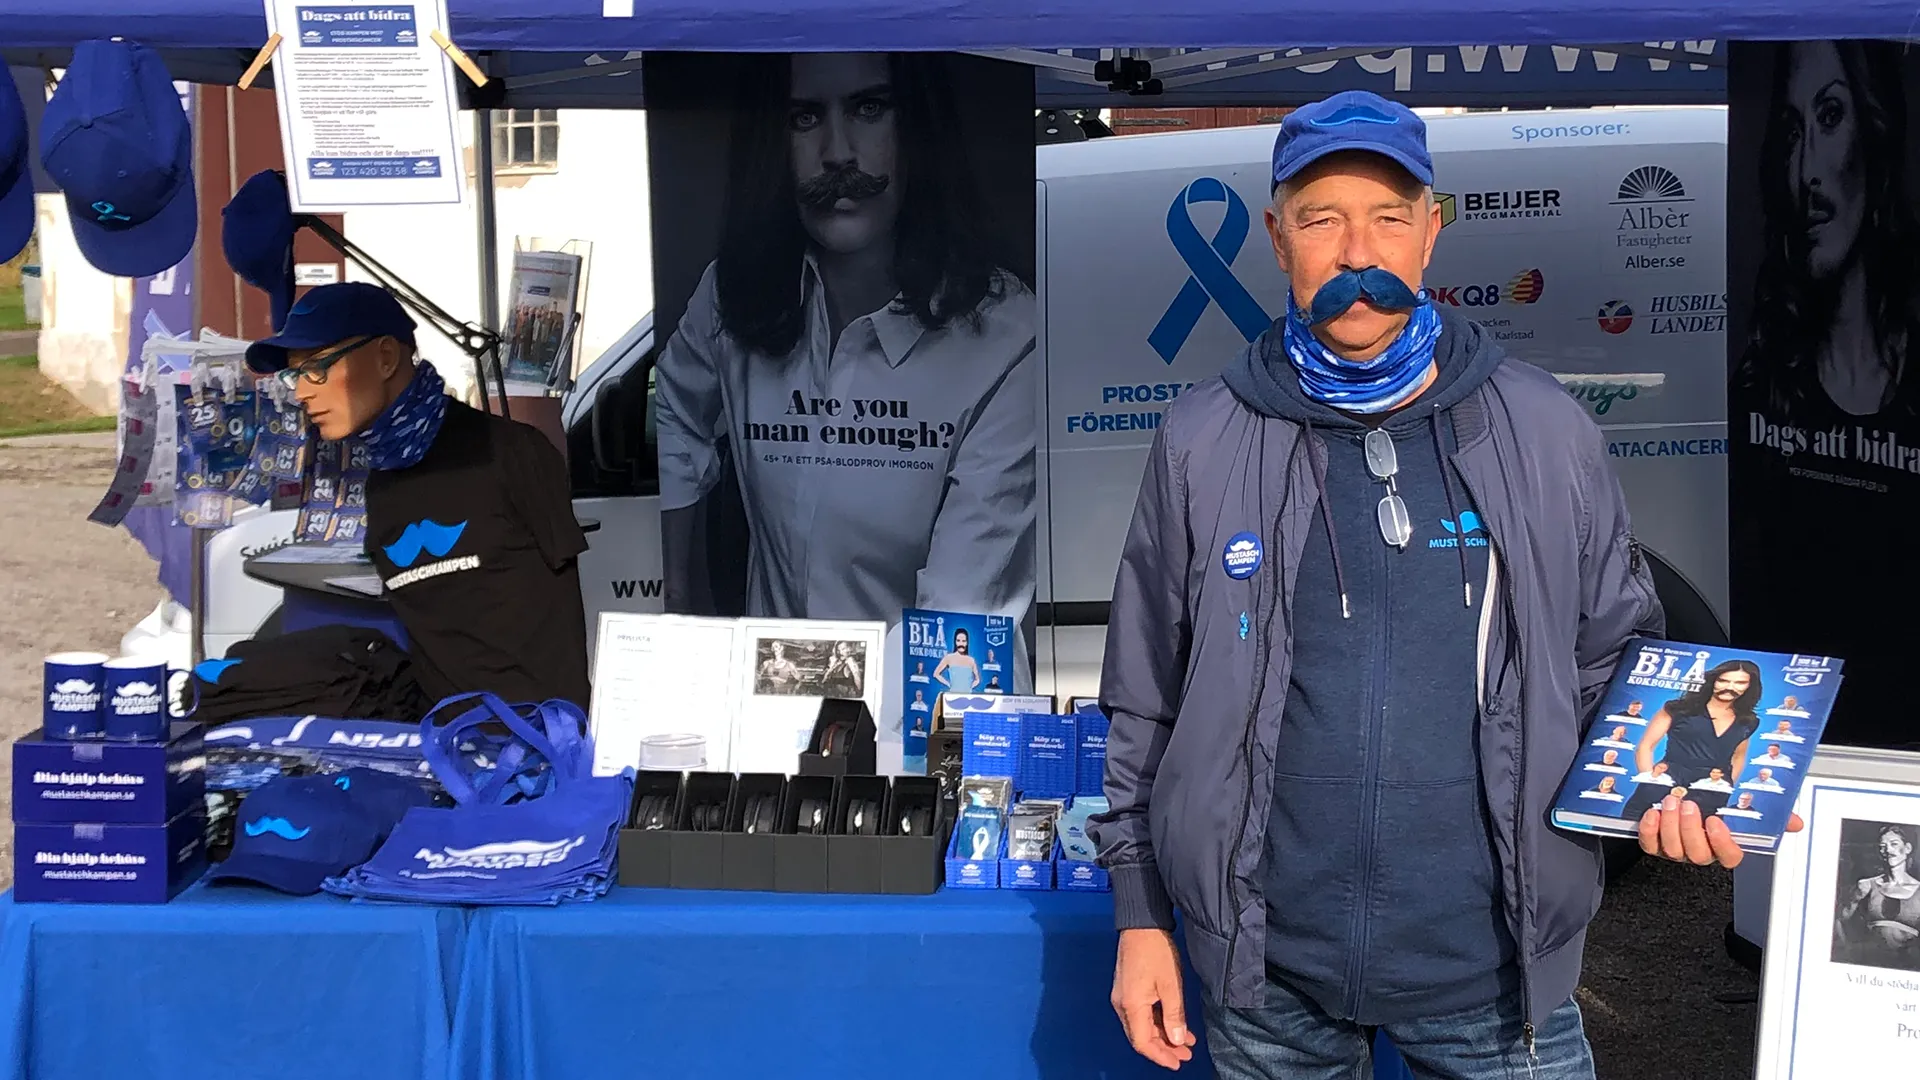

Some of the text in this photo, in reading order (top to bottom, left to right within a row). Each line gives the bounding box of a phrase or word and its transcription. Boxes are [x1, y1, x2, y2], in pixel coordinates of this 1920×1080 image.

[301, 9, 411, 22] Dags att bidra
[1511, 121, 1630, 142] Sponsorer:
[359, 167, 377, 176] 420
[380, 166, 392, 175] 52
[395, 166, 408, 175] 58
[1464, 189, 1562, 211] BEIJER
[1465, 209, 1562, 221] BYGGMATERIAL
[1617, 206, 1690, 231] Albèr
[1616, 233, 1692, 249] Fastigheter
[1625, 254, 1686, 270] Alber.se
[1495, 329, 1534, 340] Karlstad
[1103, 383, 1195, 404] PROST
[191, 403, 216, 426] 25
[784, 389, 909, 423] Are you
[743, 421, 955, 452] man enough?
[1749, 412, 1920, 475] Dags att bidra
[1606, 438, 1728, 458] ATACANCER
[763, 454, 934, 471] 45+ TA ETT PSA-BLODPROV IMORGON
[314, 478, 336, 500] 25
[307, 511, 329, 534] 25
[335, 518, 358, 540] 25
[1226, 549, 1259, 560] MUSTASCH
[1228, 557, 1256, 565] KAMPEN
[908, 616, 947, 648] BLÅ
[1630, 650, 1711, 684] BLÅ
